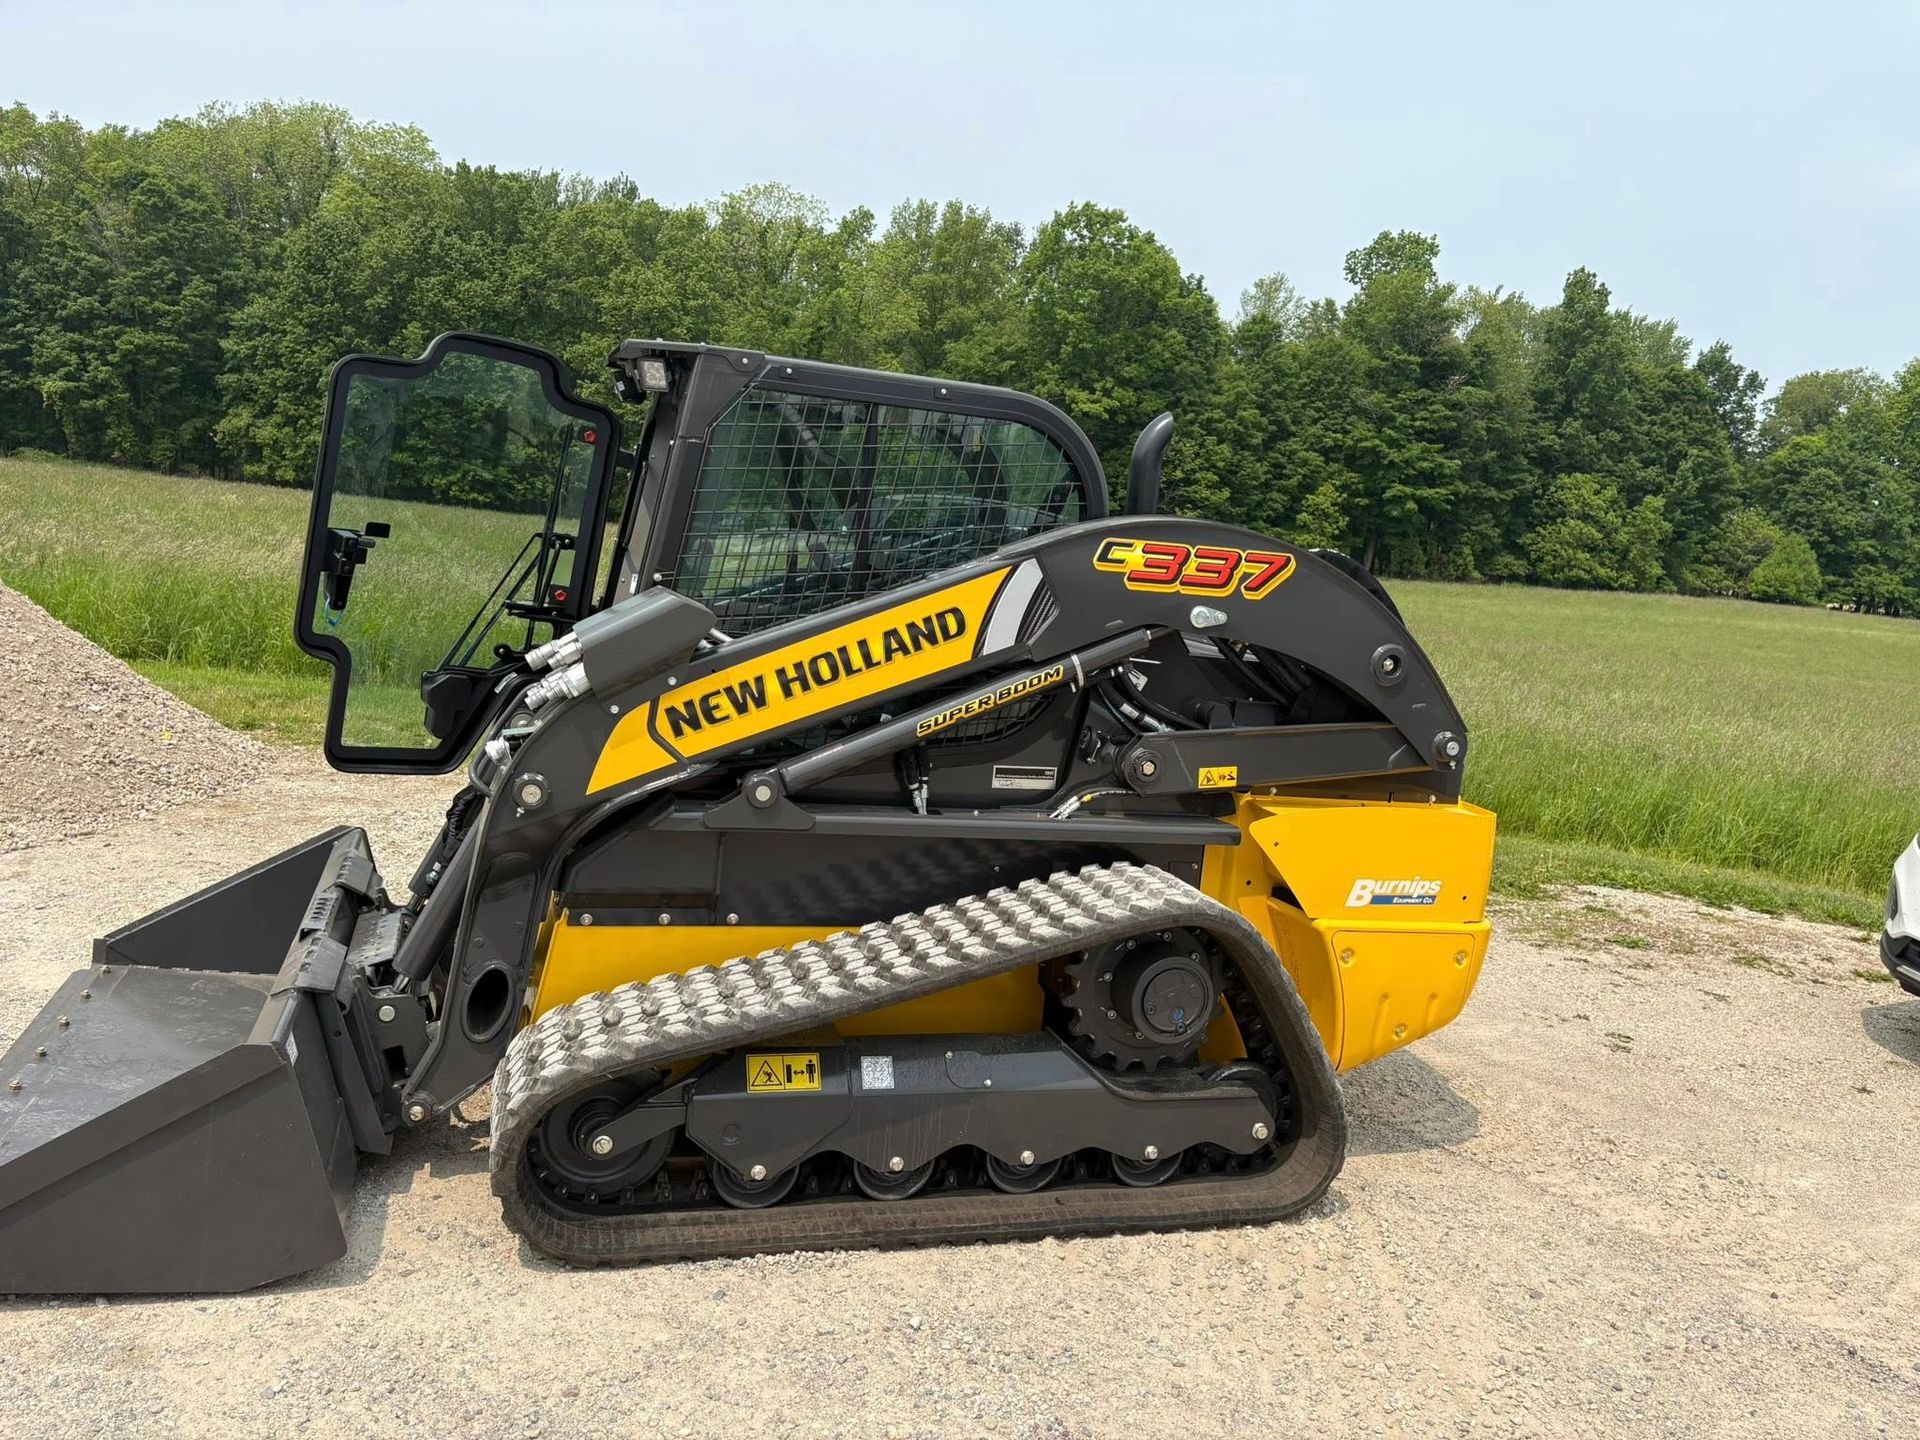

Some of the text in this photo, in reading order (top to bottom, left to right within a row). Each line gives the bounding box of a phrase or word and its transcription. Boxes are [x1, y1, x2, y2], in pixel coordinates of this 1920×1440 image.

[1093, 538, 1296, 600] C337
[664, 606, 968, 739] NEW HOLLAND
[917, 665, 1063, 737] SUPER BOOM
[1344, 876, 1442, 907] Burnips
